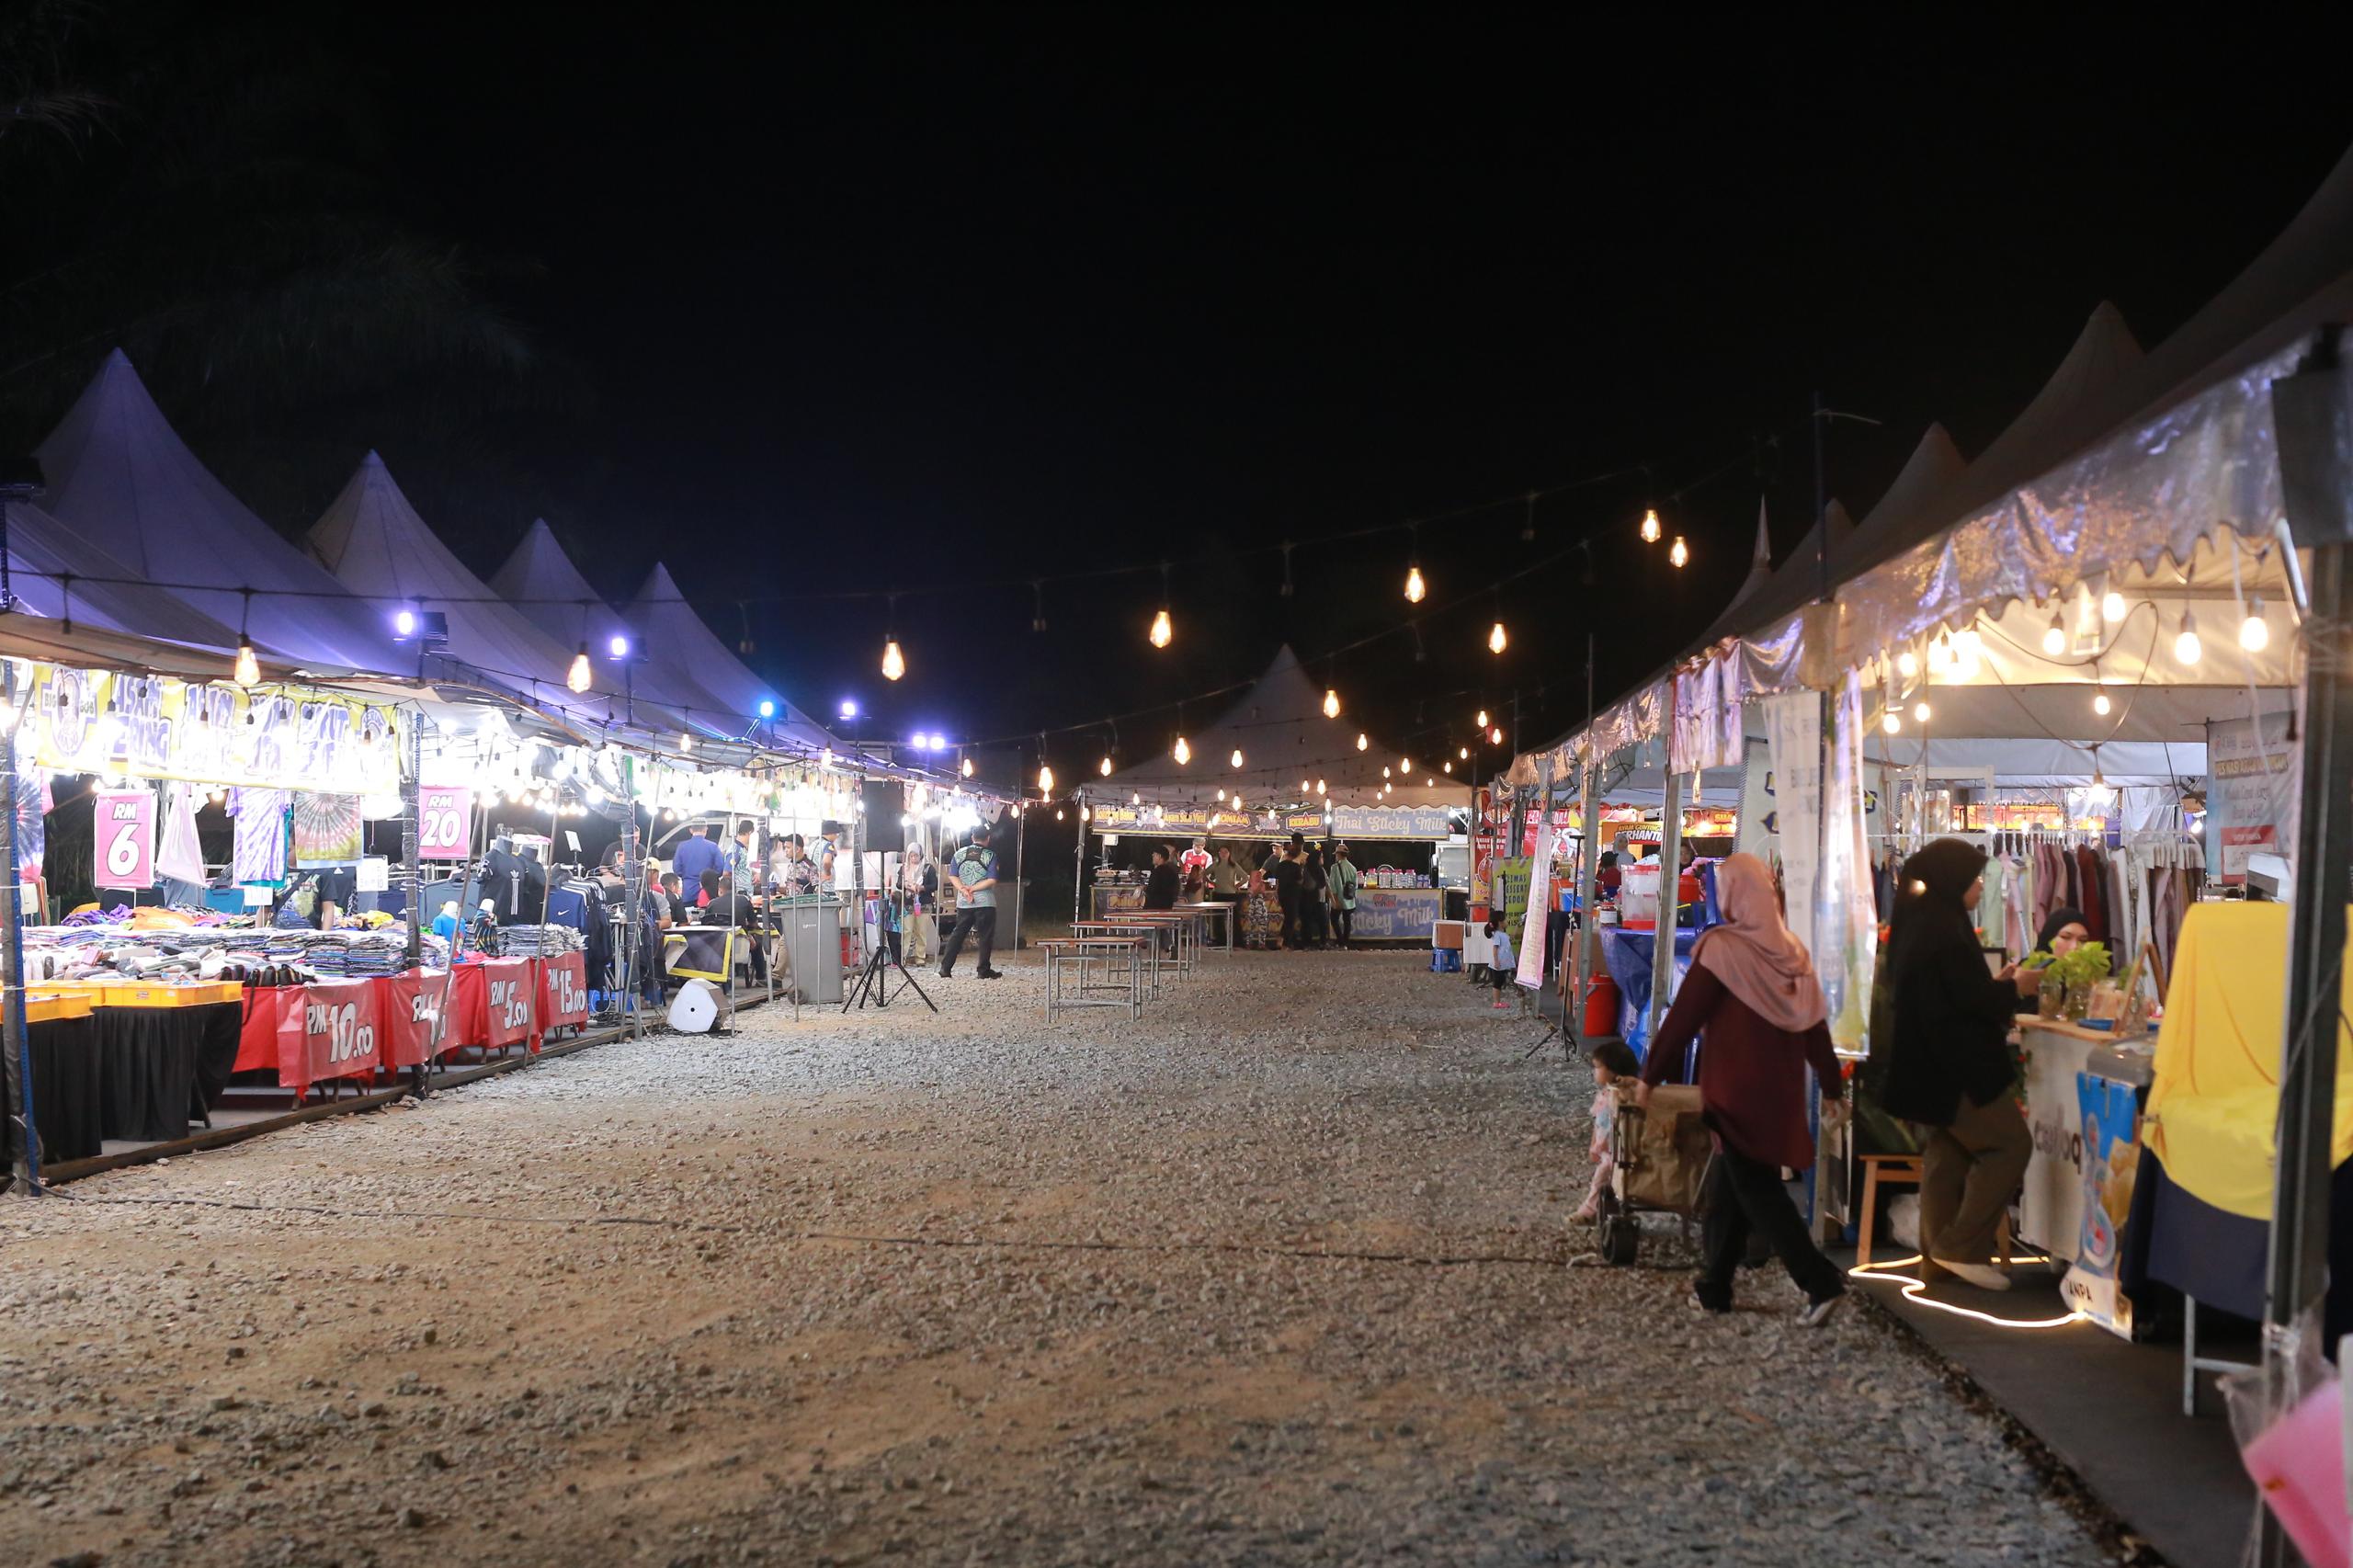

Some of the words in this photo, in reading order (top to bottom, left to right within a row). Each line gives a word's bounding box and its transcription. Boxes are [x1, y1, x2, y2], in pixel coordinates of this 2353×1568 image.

[111, 802, 137, 820] RM
[426, 795, 453, 808] RM
[419, 809, 461, 847] 20
[1335, 815, 1362, 830] Thai
[1367, 816, 1411, 835] Sticky
[1415, 816, 1447, 831] Milk
[1615, 830, 1663, 843] RHANTU
[107, 823, 142, 877] 6
[1397, 907, 1434, 927] Milk
[490, 980, 506, 1006] RM
[306, 1004, 327, 1035] RM
[329, 1001, 374, 1063] 10.00
